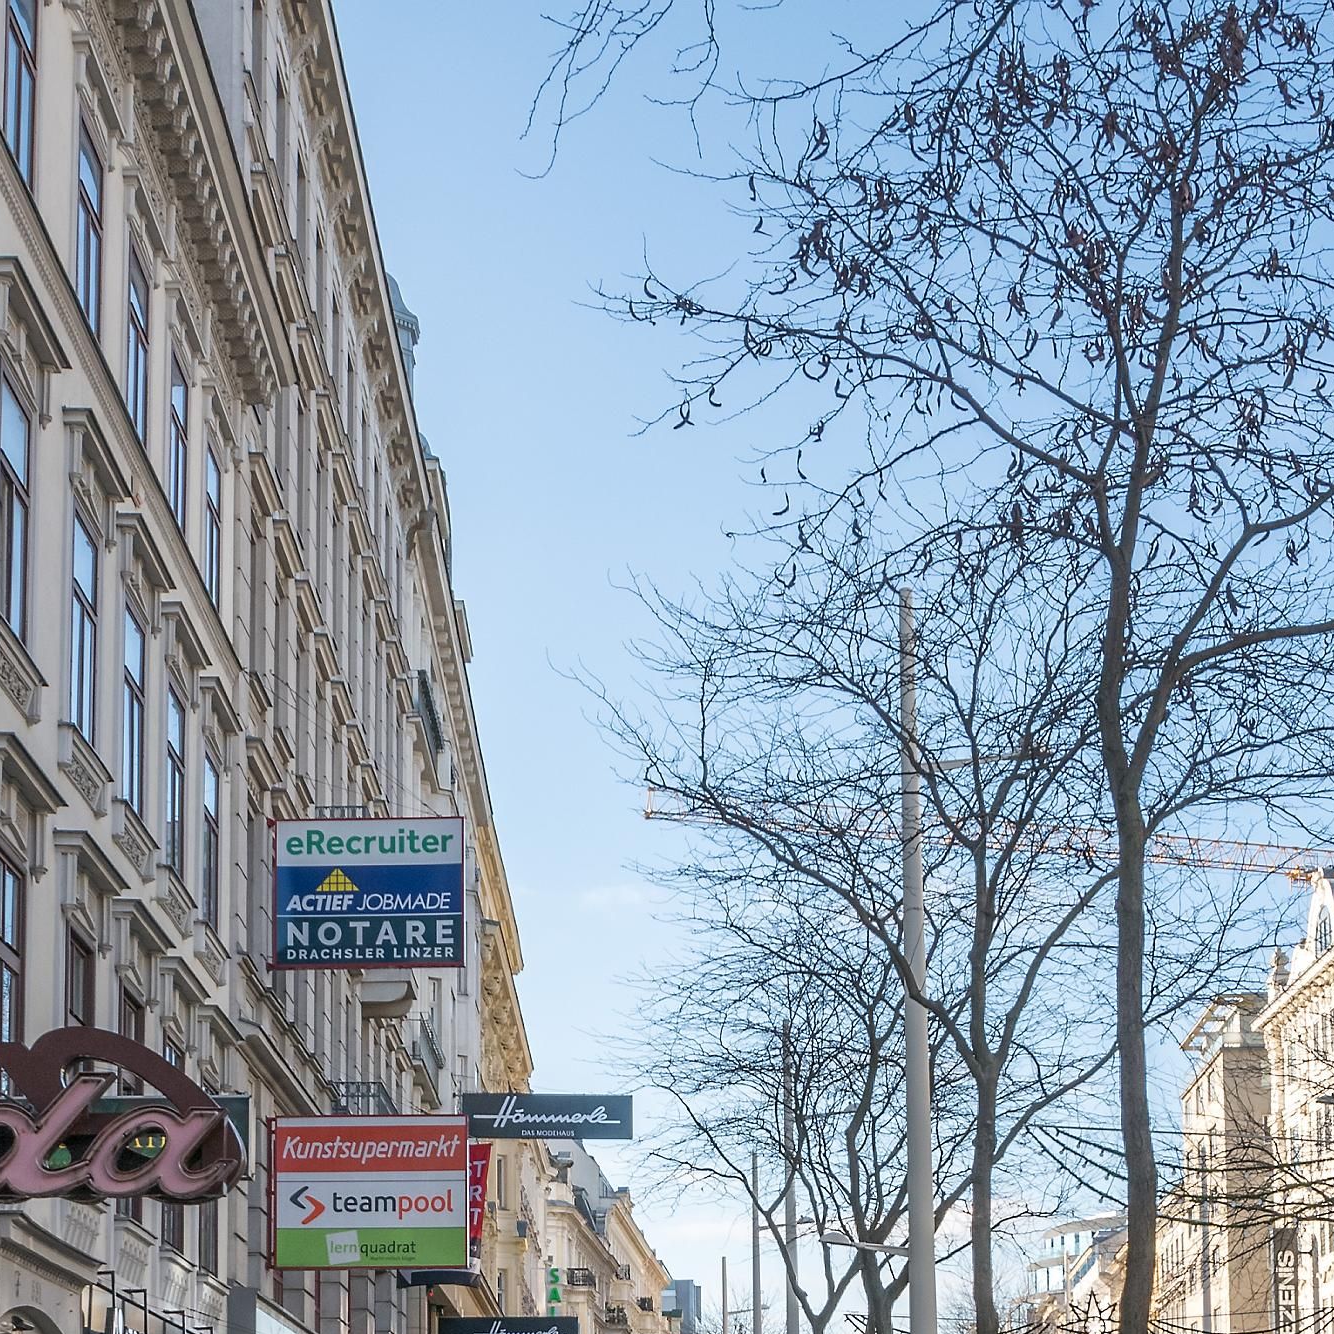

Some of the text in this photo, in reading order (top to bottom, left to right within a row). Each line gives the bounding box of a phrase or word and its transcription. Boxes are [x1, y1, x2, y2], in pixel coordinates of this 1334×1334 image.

[286, 828, 454, 855] eRecruiter
[286, 892, 451, 911] ACTIEF JOBMADE
[287, 919, 454, 946] NOTARE
[287, 947, 454, 960] DRACHSLER LINZER
[521, 1129, 575, 1137] DAS MODEHAUS
[282, 1135, 460, 1165] Kunstsupermarkt
[333, 1189, 453, 1220] teampool
[330, 1239, 417, 1256] lernquadrat
